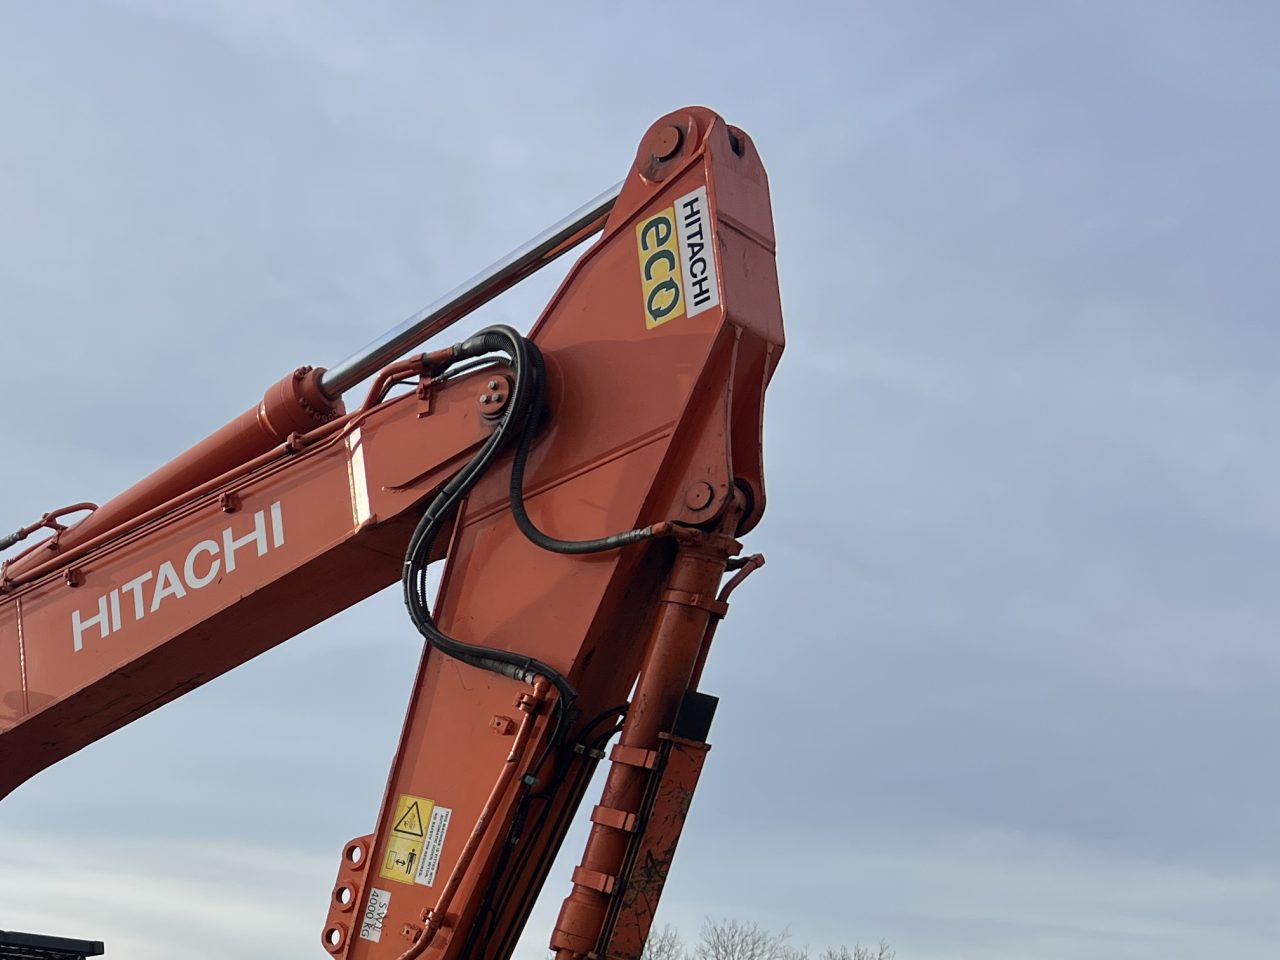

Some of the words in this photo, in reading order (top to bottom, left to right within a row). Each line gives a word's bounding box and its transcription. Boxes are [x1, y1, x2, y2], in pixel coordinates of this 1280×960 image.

[683, 197, 710, 306] HITACHI
[72, 501, 284, 652] HITACHI
[366, 890, 379, 919] 4000
